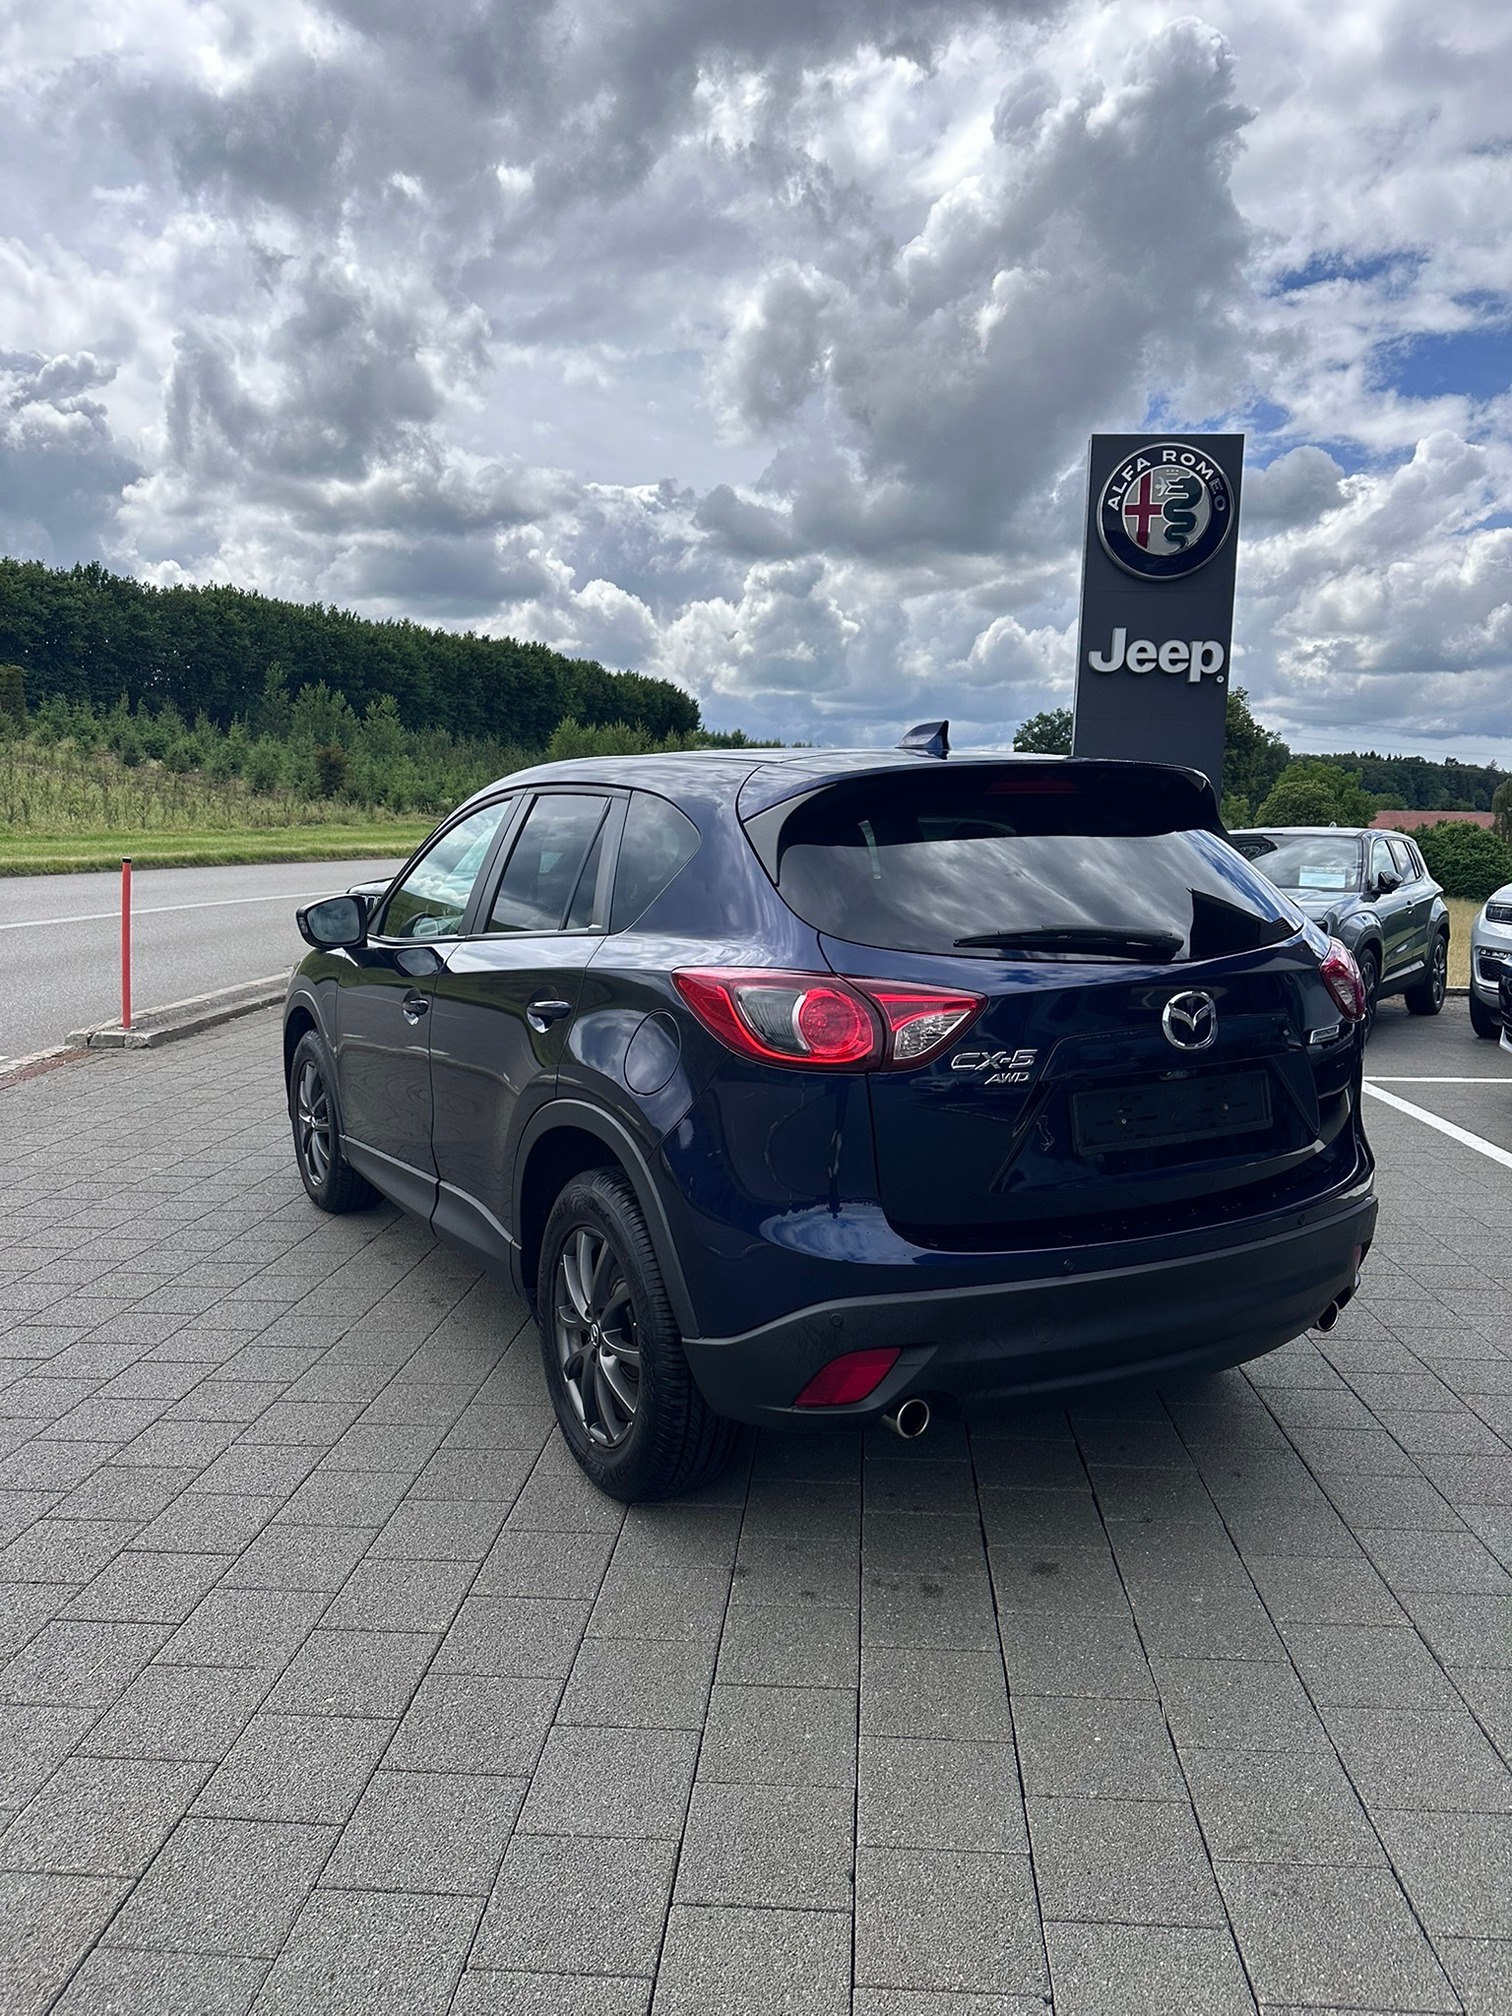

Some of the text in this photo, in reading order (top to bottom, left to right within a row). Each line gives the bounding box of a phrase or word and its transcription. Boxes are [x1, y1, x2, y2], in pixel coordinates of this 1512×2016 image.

[1107, 449, 1227, 512] ALFA ROMEO
[950, 1049, 1038, 1071] CX-5
[984, 1071, 1030, 1085] AWD
